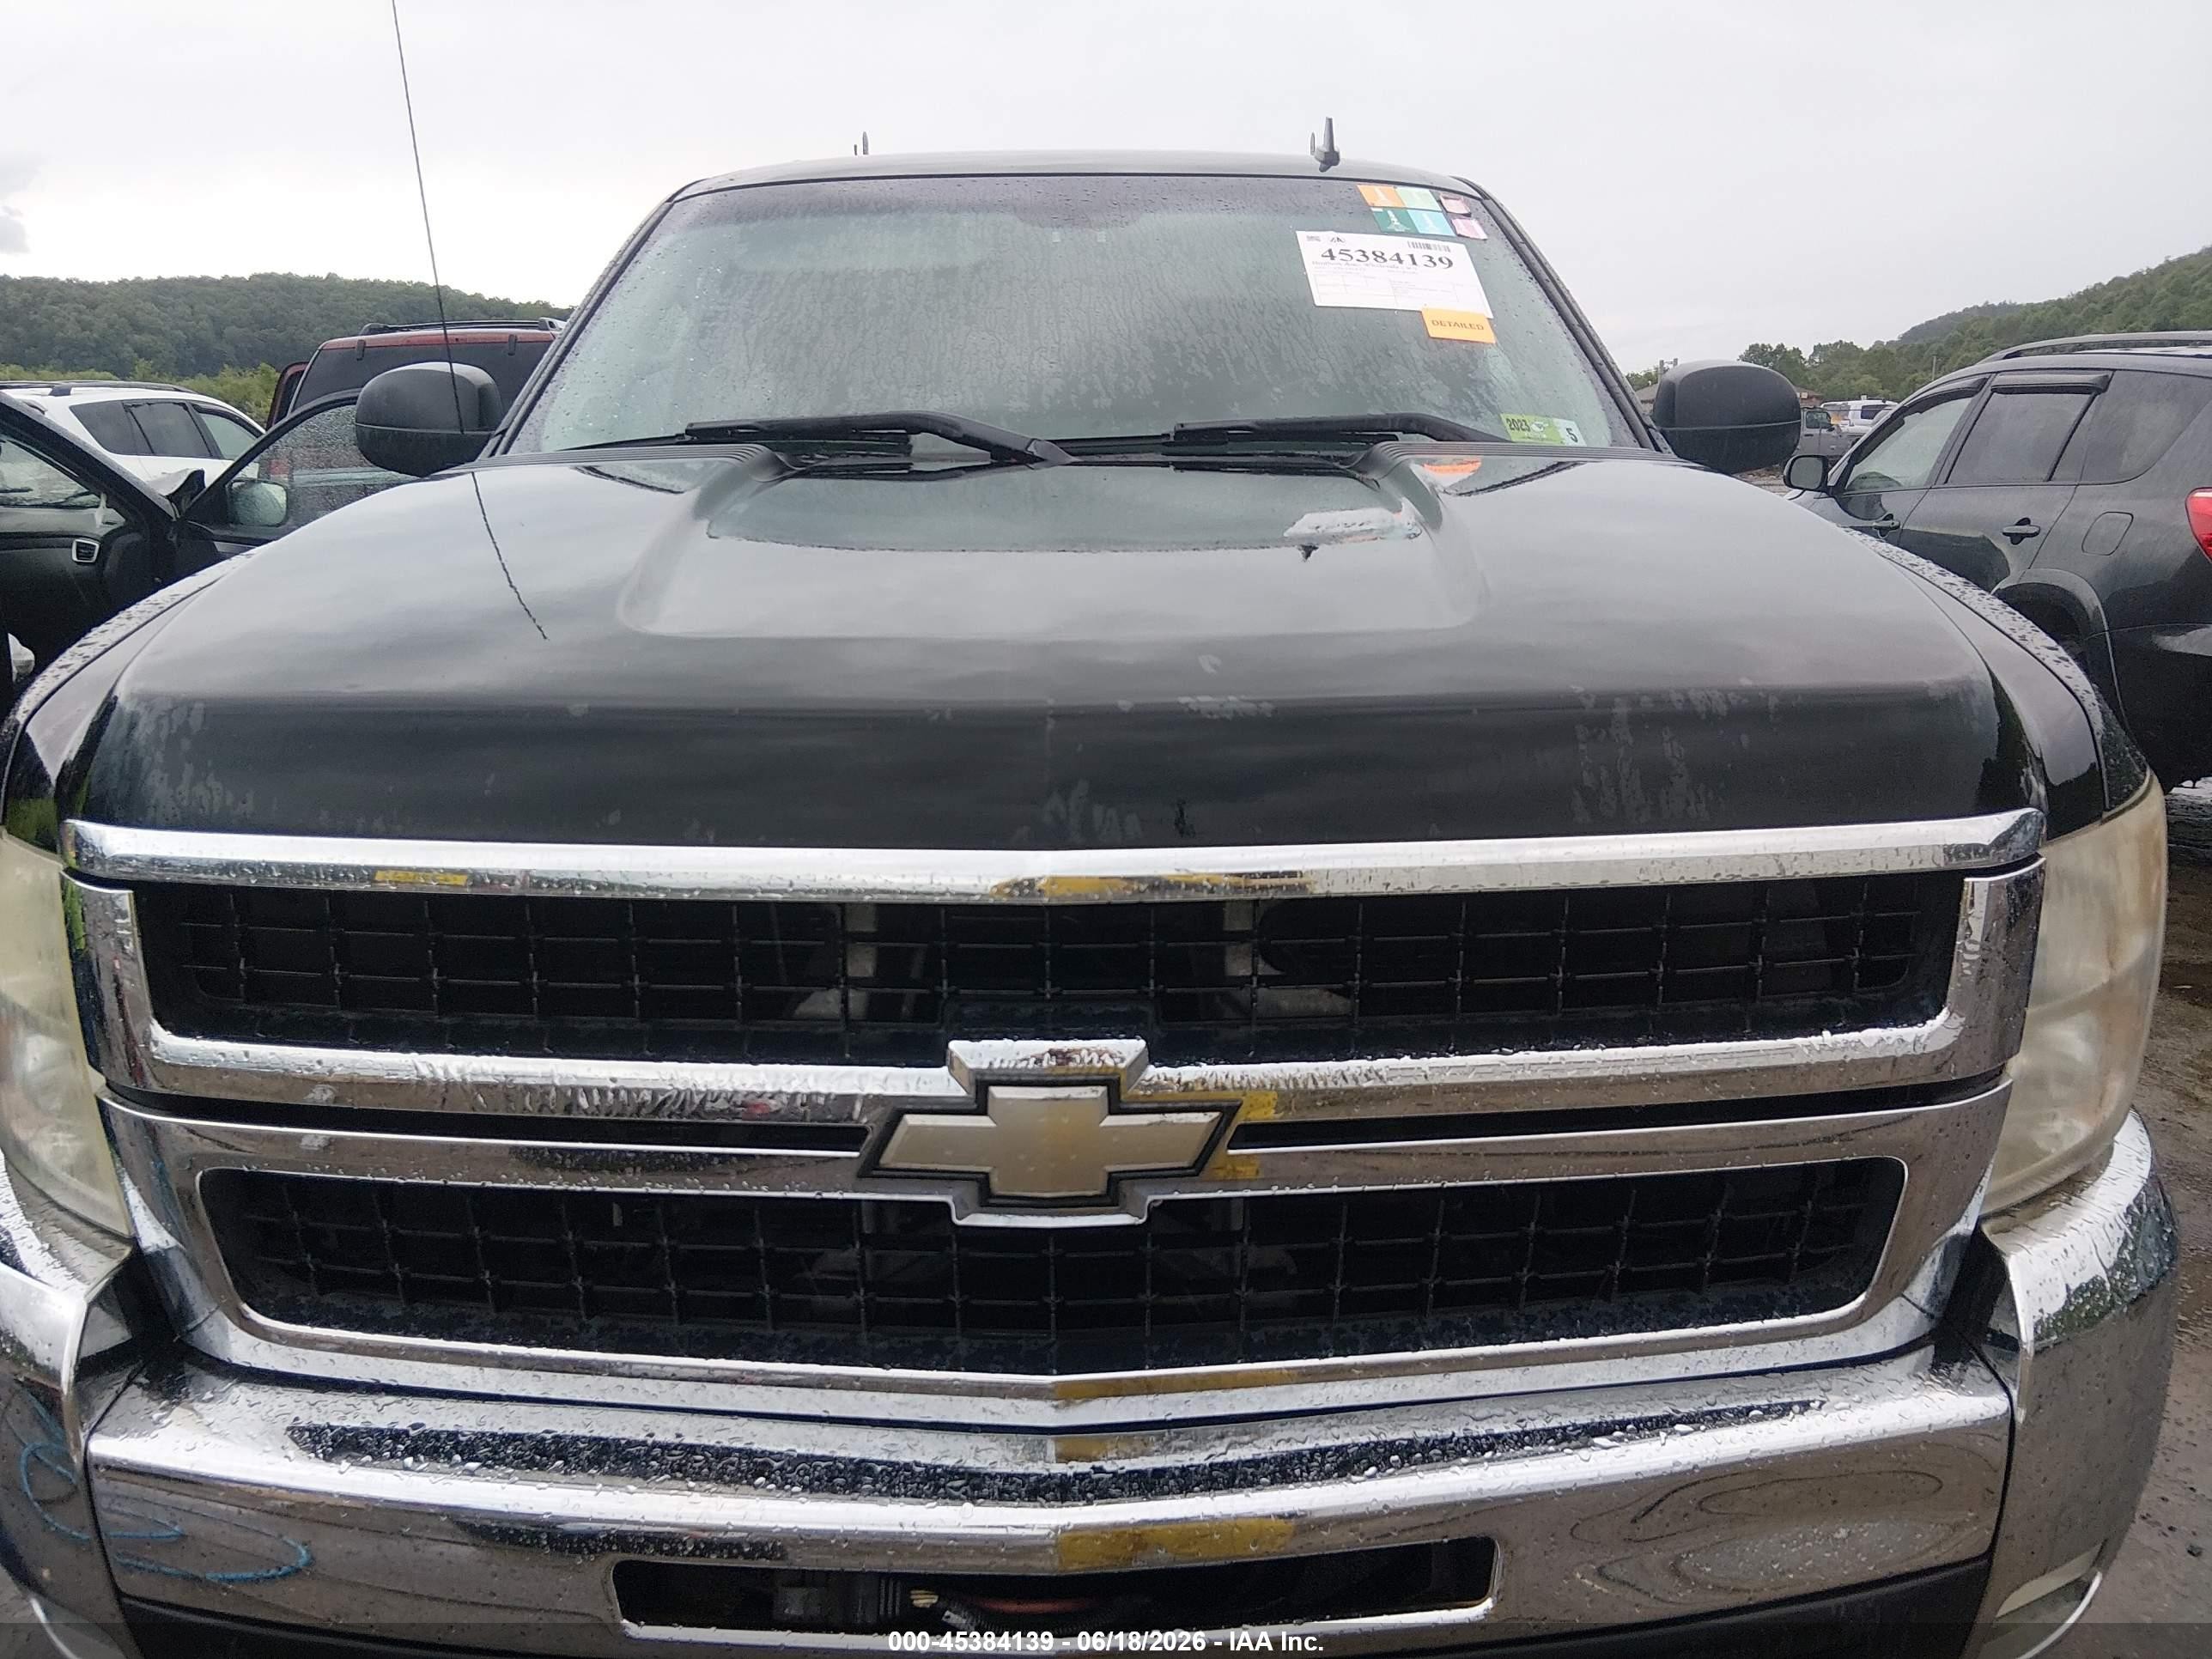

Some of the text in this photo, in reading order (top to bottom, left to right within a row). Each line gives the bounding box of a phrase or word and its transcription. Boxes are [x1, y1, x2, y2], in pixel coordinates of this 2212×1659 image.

[1321, 247, 1454, 270] 45384139
[1431, 319, 1485, 331] DETAILED
[1506, 418, 1530, 432] 2023
[1565, 428, 1578, 443] 5
